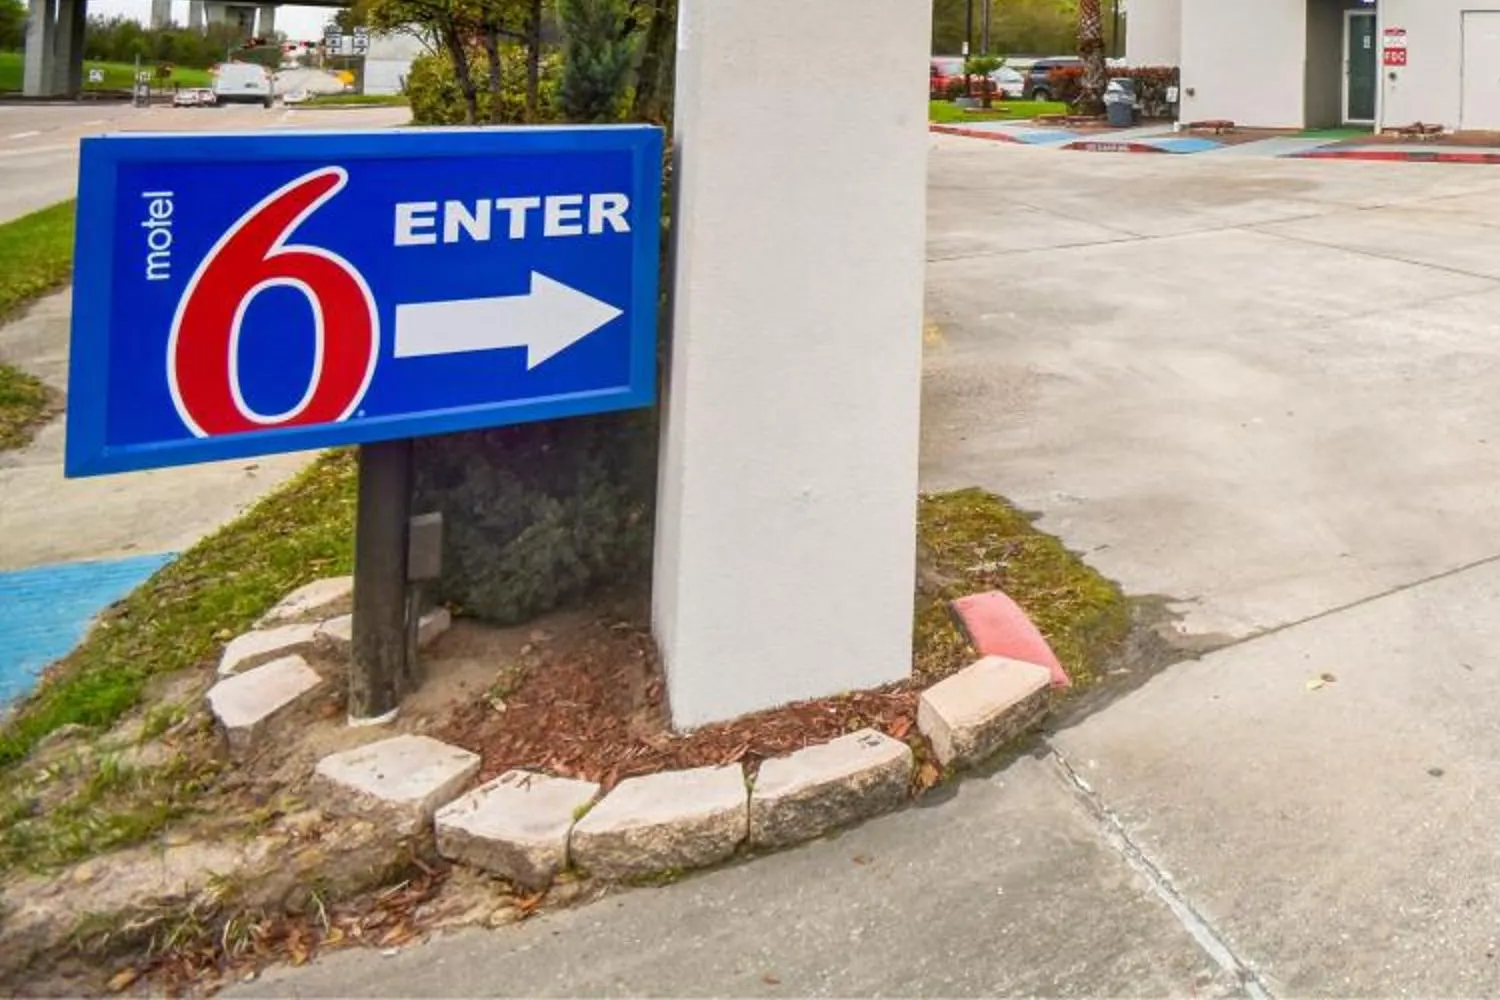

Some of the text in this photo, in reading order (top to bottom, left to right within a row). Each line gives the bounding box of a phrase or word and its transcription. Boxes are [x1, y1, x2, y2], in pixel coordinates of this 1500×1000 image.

[393, 192, 631, 247] ENTER
[141, 165, 380, 439] motel 6
